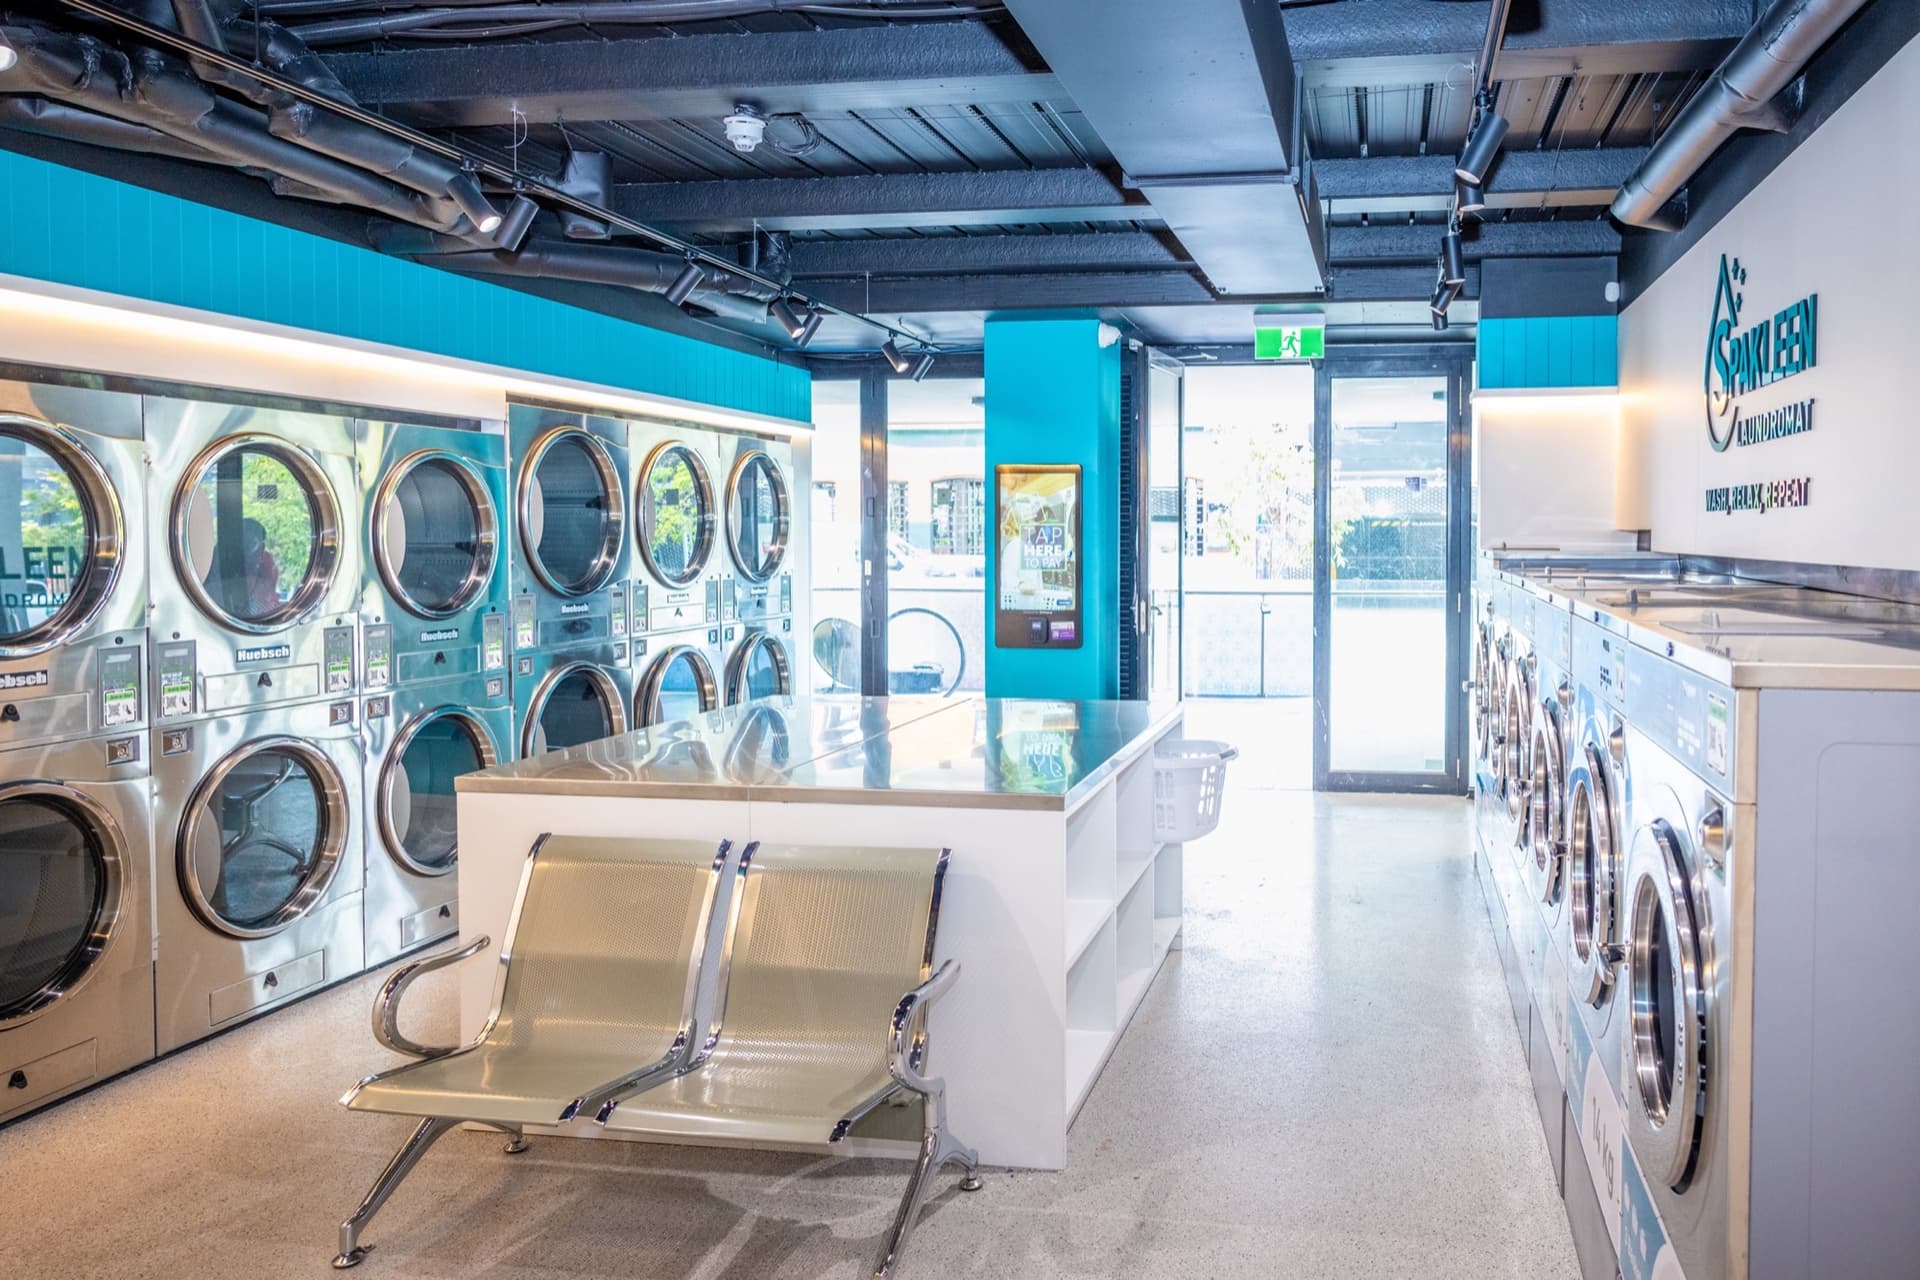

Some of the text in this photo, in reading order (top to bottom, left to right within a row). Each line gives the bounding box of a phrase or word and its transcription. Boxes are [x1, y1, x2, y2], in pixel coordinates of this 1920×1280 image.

[1713, 293, 1818, 417] SPAKLEEN
[1737, 397, 1815, 447] LAUNDROMAT
[1765, 477, 1811, 509] REPEAT
[1024, 527, 1062, 544] TAP
[1024, 544, 1062, 557] HERE
[1024, 558, 1062, 568] TO PAY
[237, 645, 290, 662] Huebsch
